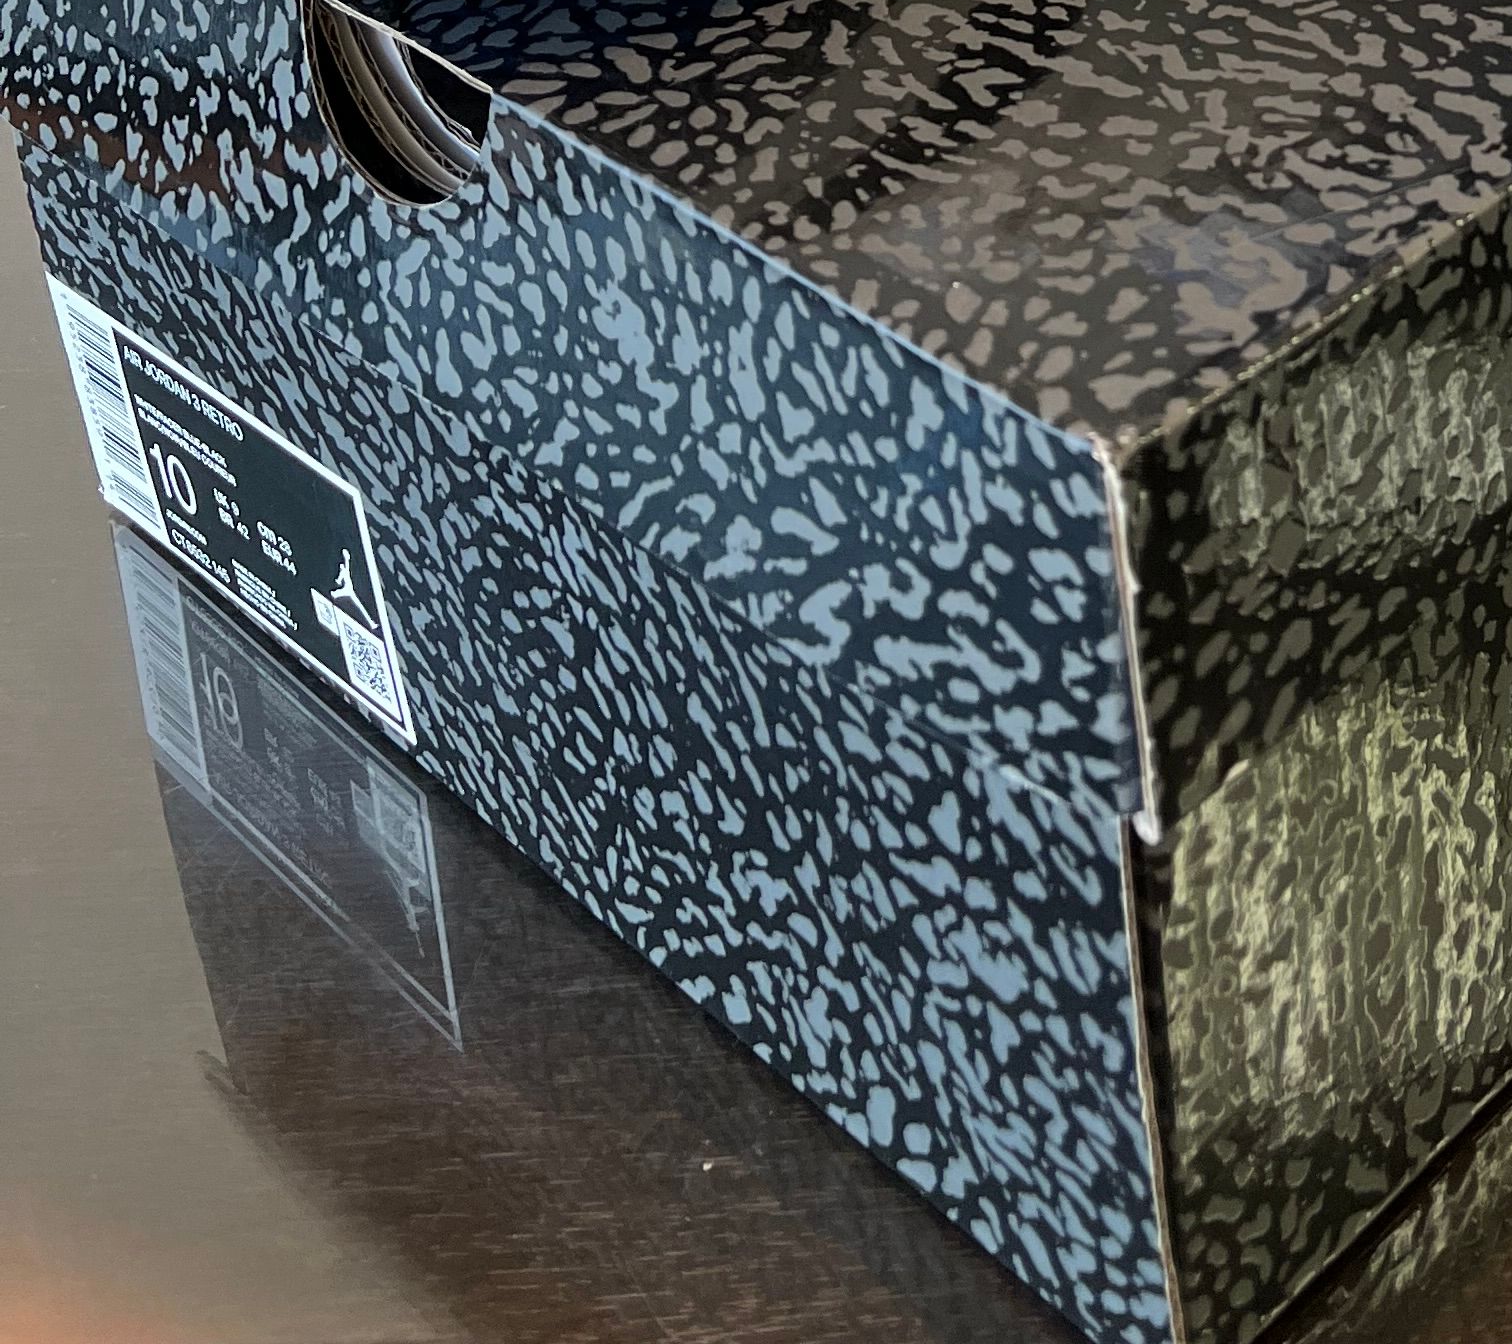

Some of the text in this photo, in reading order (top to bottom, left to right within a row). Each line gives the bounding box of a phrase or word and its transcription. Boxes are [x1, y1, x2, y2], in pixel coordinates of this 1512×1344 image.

[143, 360, 191, 405] JORDAN
[191, 393, 201, 412] 3
[201, 399, 244, 441] RETRO
[149, 443, 196, 516] 10
